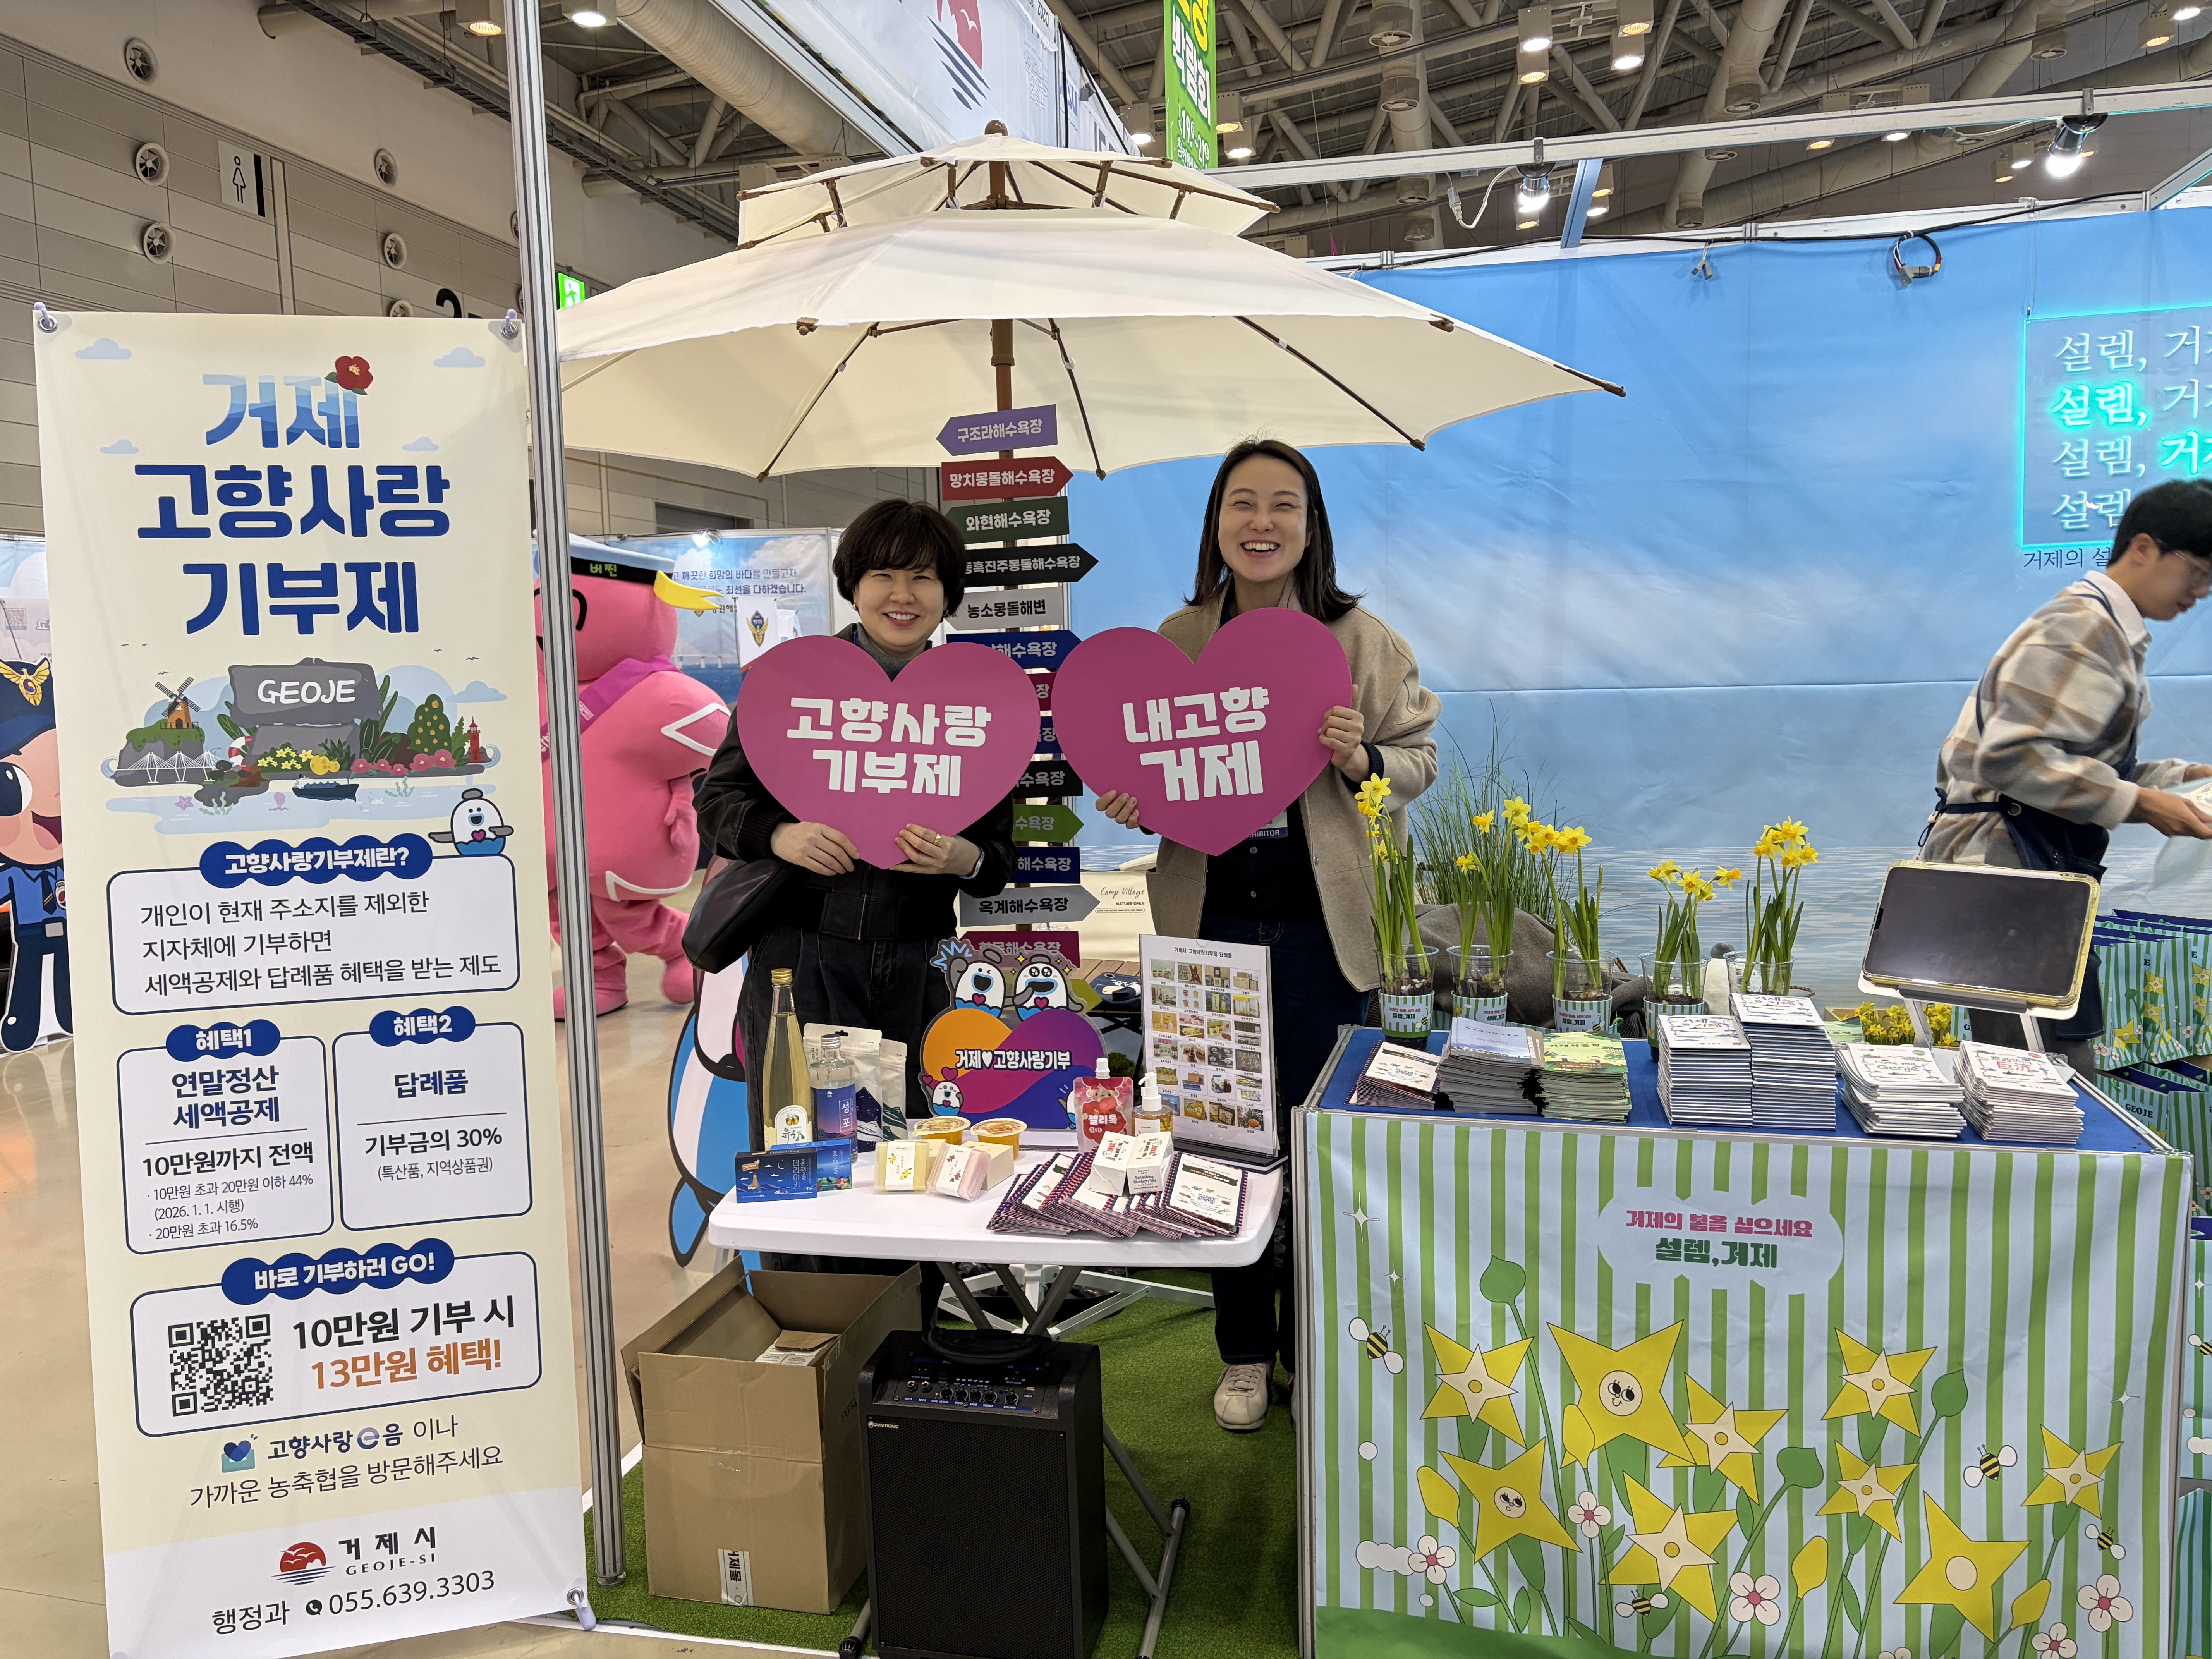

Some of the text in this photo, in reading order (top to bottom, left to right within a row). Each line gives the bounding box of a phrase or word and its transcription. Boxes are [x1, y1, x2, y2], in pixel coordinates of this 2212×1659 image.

[1172, 5, 1211, 126] 박람회
[2055, 325, 2212, 372] 설렘, 거
[203, 374, 360, 448] 거제
[2052, 379, 2212, 426] 설렘, 거
[958, 419, 1042, 442] 구조라해수욕장
[2054, 431, 2212, 478] 설렘, 거
[950, 469, 1055, 488] 망치몽돌해수욕장
[134, 464, 451, 538] 고향사랑
[966, 509, 1051, 531] 와현해수욕장
[965, 556, 1080, 574] 동흑진주몽돌해수욕장
[2023, 546, 2111, 570] 거제의 설
[682, 571, 706, 580] 깨끗한
[709, 570, 733, 579] 희망의
[736, 569, 760, 579] 바다를
[763, 569, 797, 579] 만들고자
[182, 561, 419, 635] 기부제
[726, 584, 806, 594] 최선을 다하겠습니다.
[967, 599, 1046, 619] 농소몽돌해변
[991, 641, 1057, 658] 해수욕장
[257, 678, 356, 705] GEOJE
[786, 696, 992, 747] 고향사랑
[1122, 685, 1270, 744] 내고향
[812, 748, 962, 798] 기부제
[1139, 739, 1264, 803] 거제
[1249, 830, 1280, 838] HIBITOR
[225, 847, 410, 876] 고향사랑기부제란?
[1018, 857, 1072, 872] 해수욕장
[979, 896, 1069, 915] 옥계해수욕장
[1101, 887, 1145, 899] Camp Village
[141, 890, 429, 927] 개인이 현재 주소지를 제외한
[143, 930, 333, 962] 지자체에 기부하면
[144, 953, 502, 996] 세액공제와 답례품 혜택을 받는 제도
[393, 1014, 453, 1037] 혜택2
[195, 1028, 253, 1052] 혜택1
[172, 1065, 279, 1098] 연말정산
[394, 1069, 468, 1099] 답례품
[173, 1097, 280, 1129] 세액공제
[841, 1102, 851, 1128] 성포
[1088, 1114, 1118, 1125] 젤리톡
[2125, 1103, 2153, 1118] GEOJE
[364, 1127, 503, 1157] 기부금의 30%
[143, 1140, 314, 1178] 10만원까지 전액
[378, 1158, 493, 1183] (특산품, 지역상품권)
[153, 1174, 314, 1201] 10만원 초과 20만원 이하 44%
[154, 1204, 191, 1222] (2026.
[215, 1198, 244, 1216] 시행)
[1626, 1210, 1813, 1237] 거제의 봄을 심으세요
[155, 1218, 259, 1241] 20만원 초과 16.5%
[1656, 1237, 1777, 1268] 설렘,거제
[254, 1252, 436, 1291] 바로 기부하러 GO!
[293, 1295, 515, 1350] 10만원 기부 시
[311, 1338, 502, 1390] 13만원 혜택!
[413, 1415, 458, 1441] 이나
[190, 1445, 504, 1509] 가까운 농축협을 방문해주세요
[345, 1553, 436, 1576] GEOJE-SI
[211, 1570, 495, 1636] 행정과 055.639.3303
